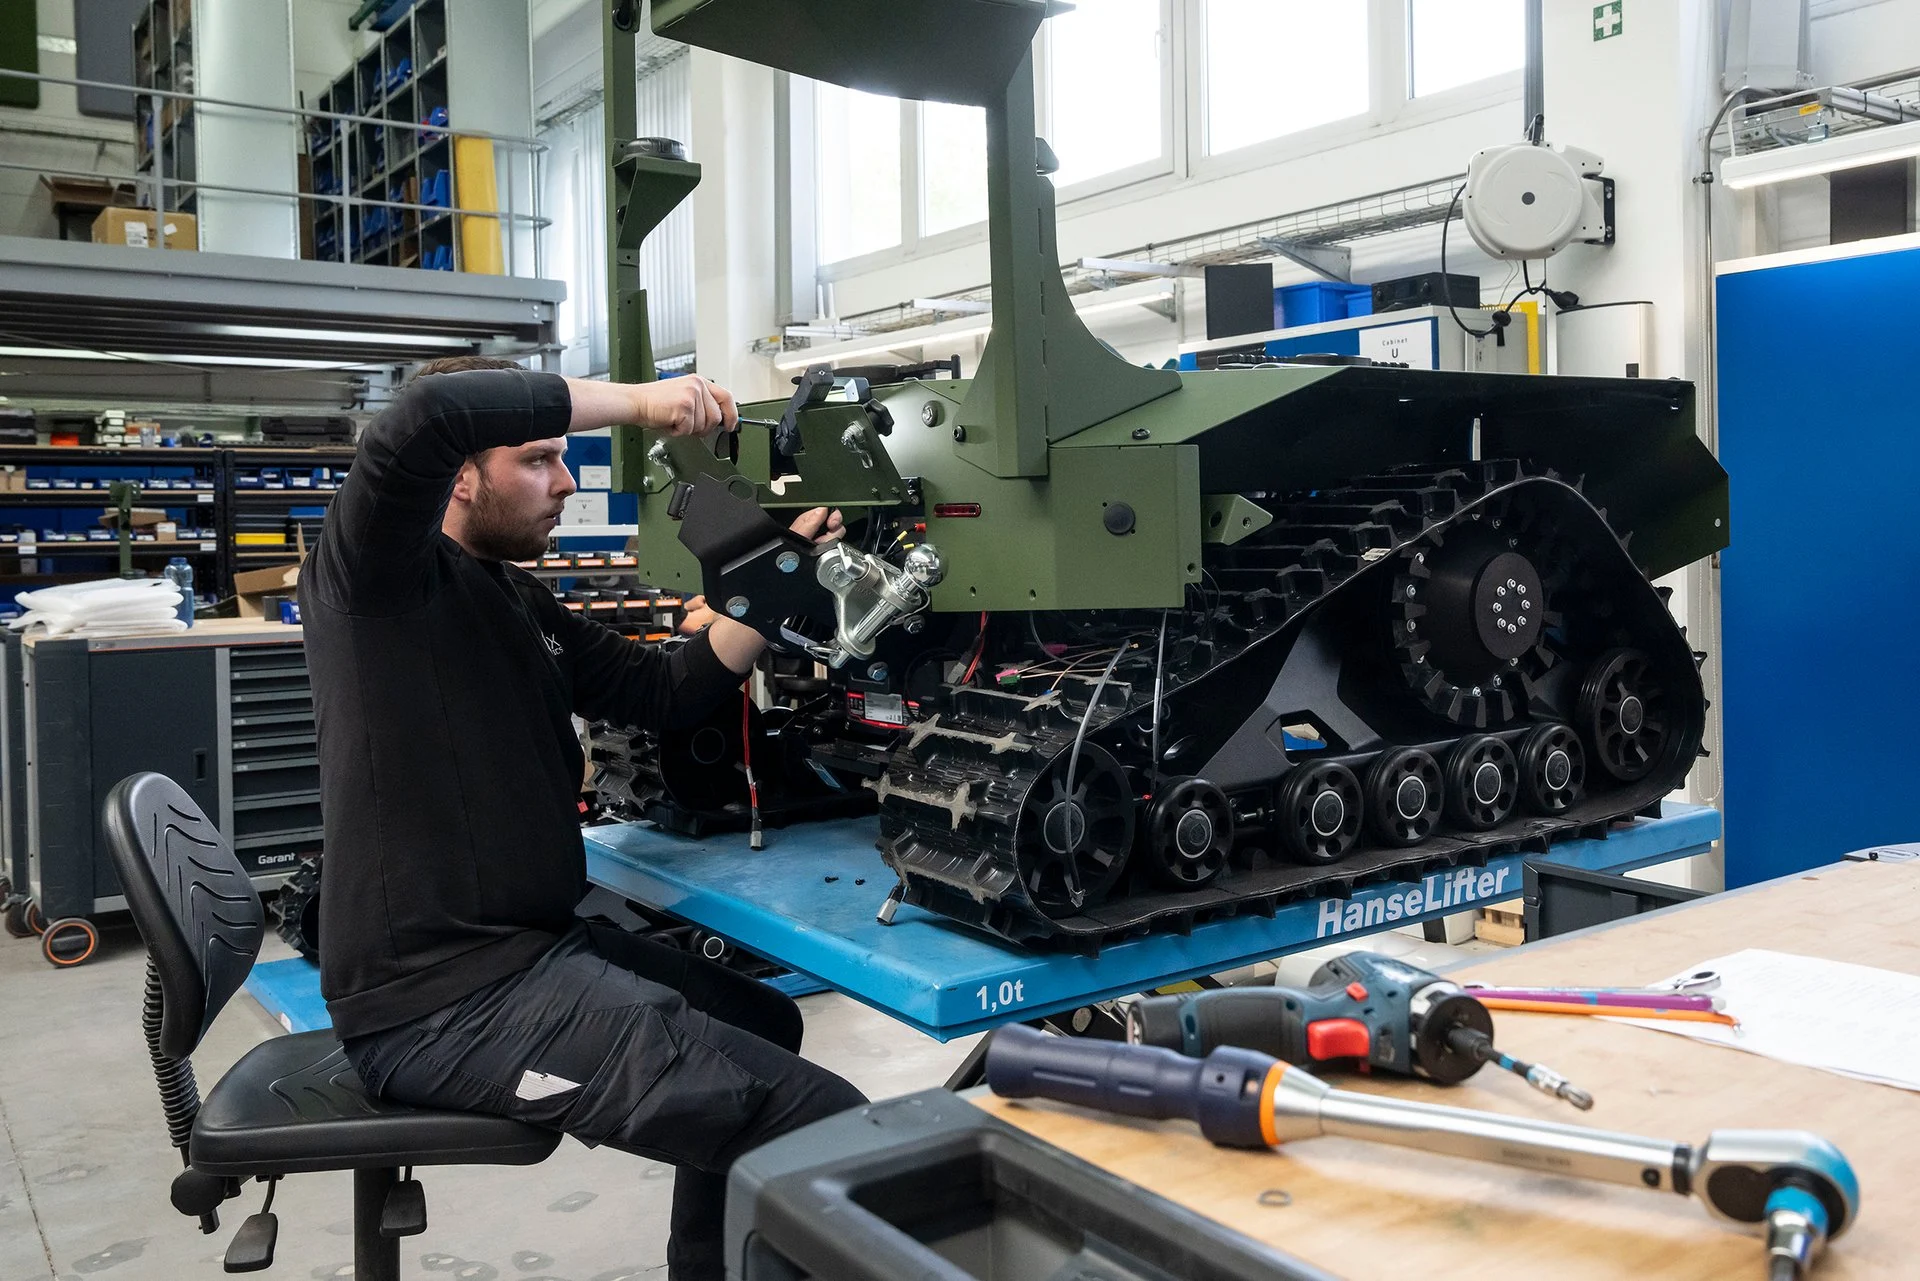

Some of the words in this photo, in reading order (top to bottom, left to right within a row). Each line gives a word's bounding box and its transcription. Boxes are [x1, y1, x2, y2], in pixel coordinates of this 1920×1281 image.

[1382, 337, 1408, 347] Cabinet
[1391, 348, 1399, 359] U
[258, 852, 296, 865] Garant
[1316, 866, 1510, 940] HanseLifter
[976, 979, 1024, 1013] 1,0t
